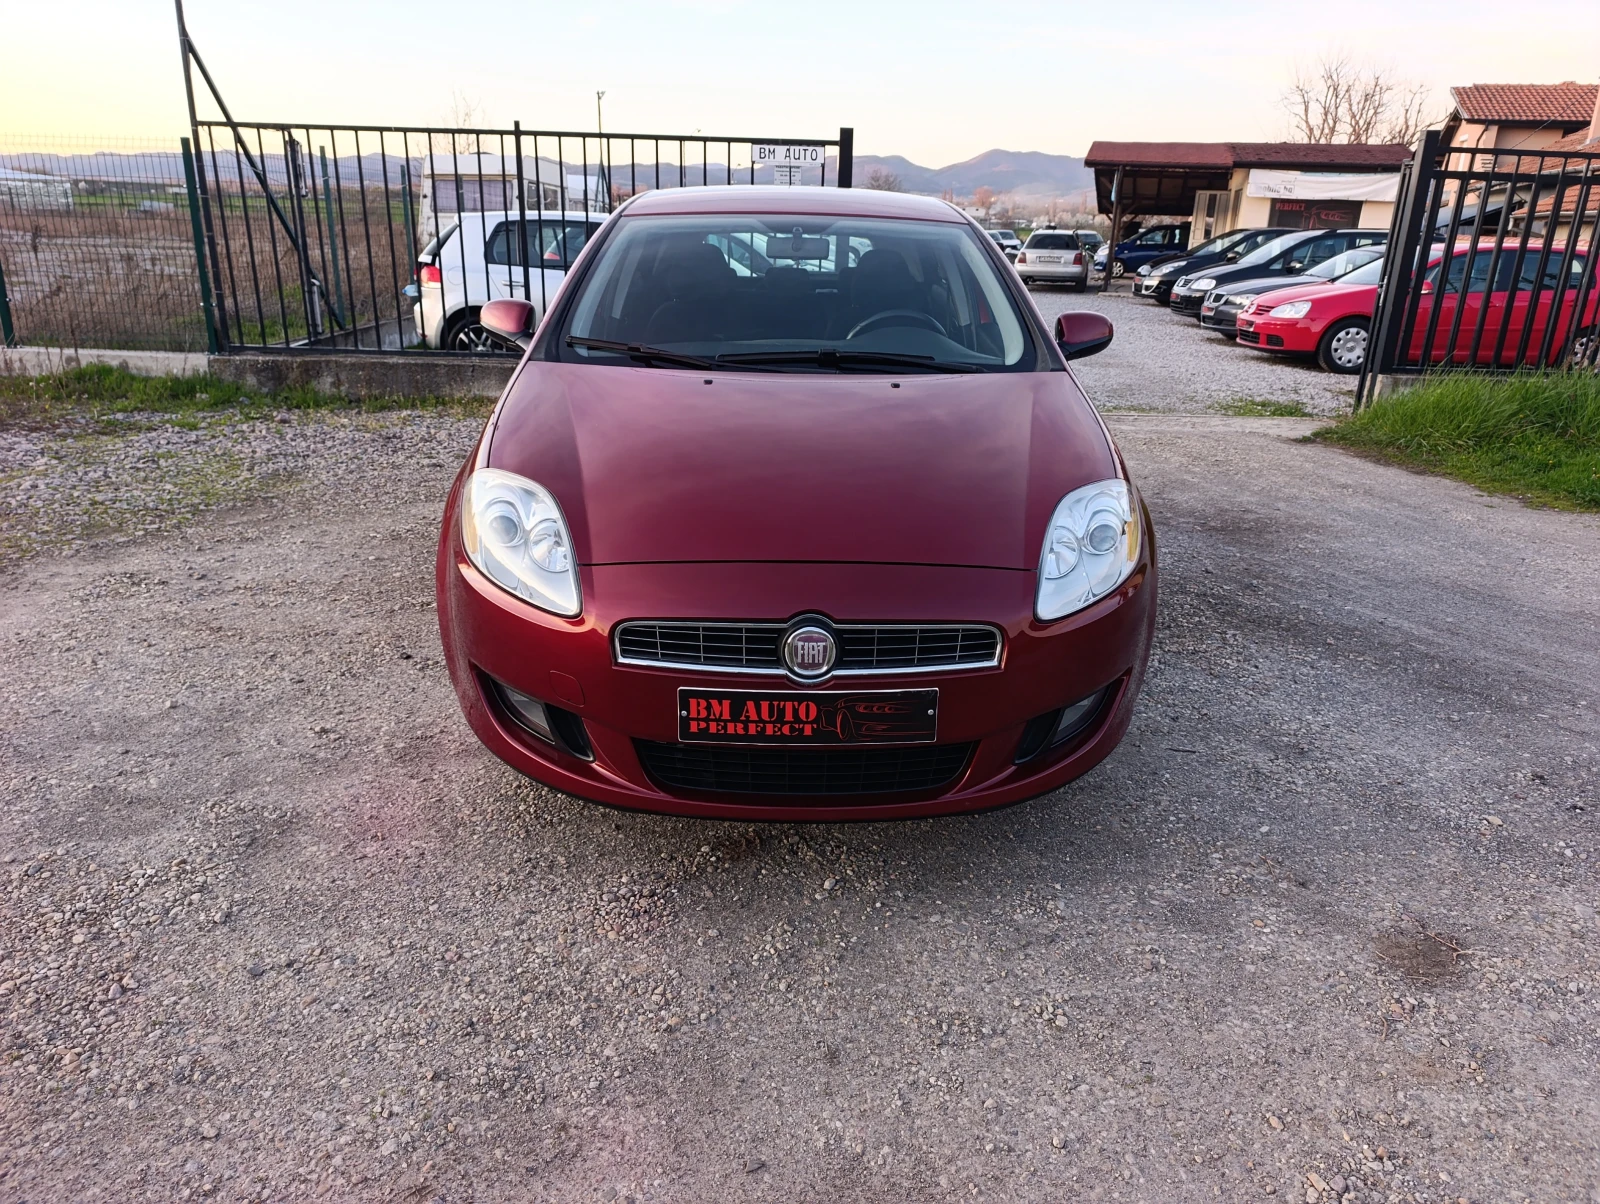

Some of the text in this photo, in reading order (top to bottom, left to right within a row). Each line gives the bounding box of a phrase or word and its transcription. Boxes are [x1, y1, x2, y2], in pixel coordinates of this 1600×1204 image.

[759, 147, 818, 161] BM AUTO
[1275, 202, 1306, 211] PERFECT
[796, 641, 826, 664] FIAT
[688, 698, 818, 721] BM AUTO
[689, 720, 818, 736] PERFECT
